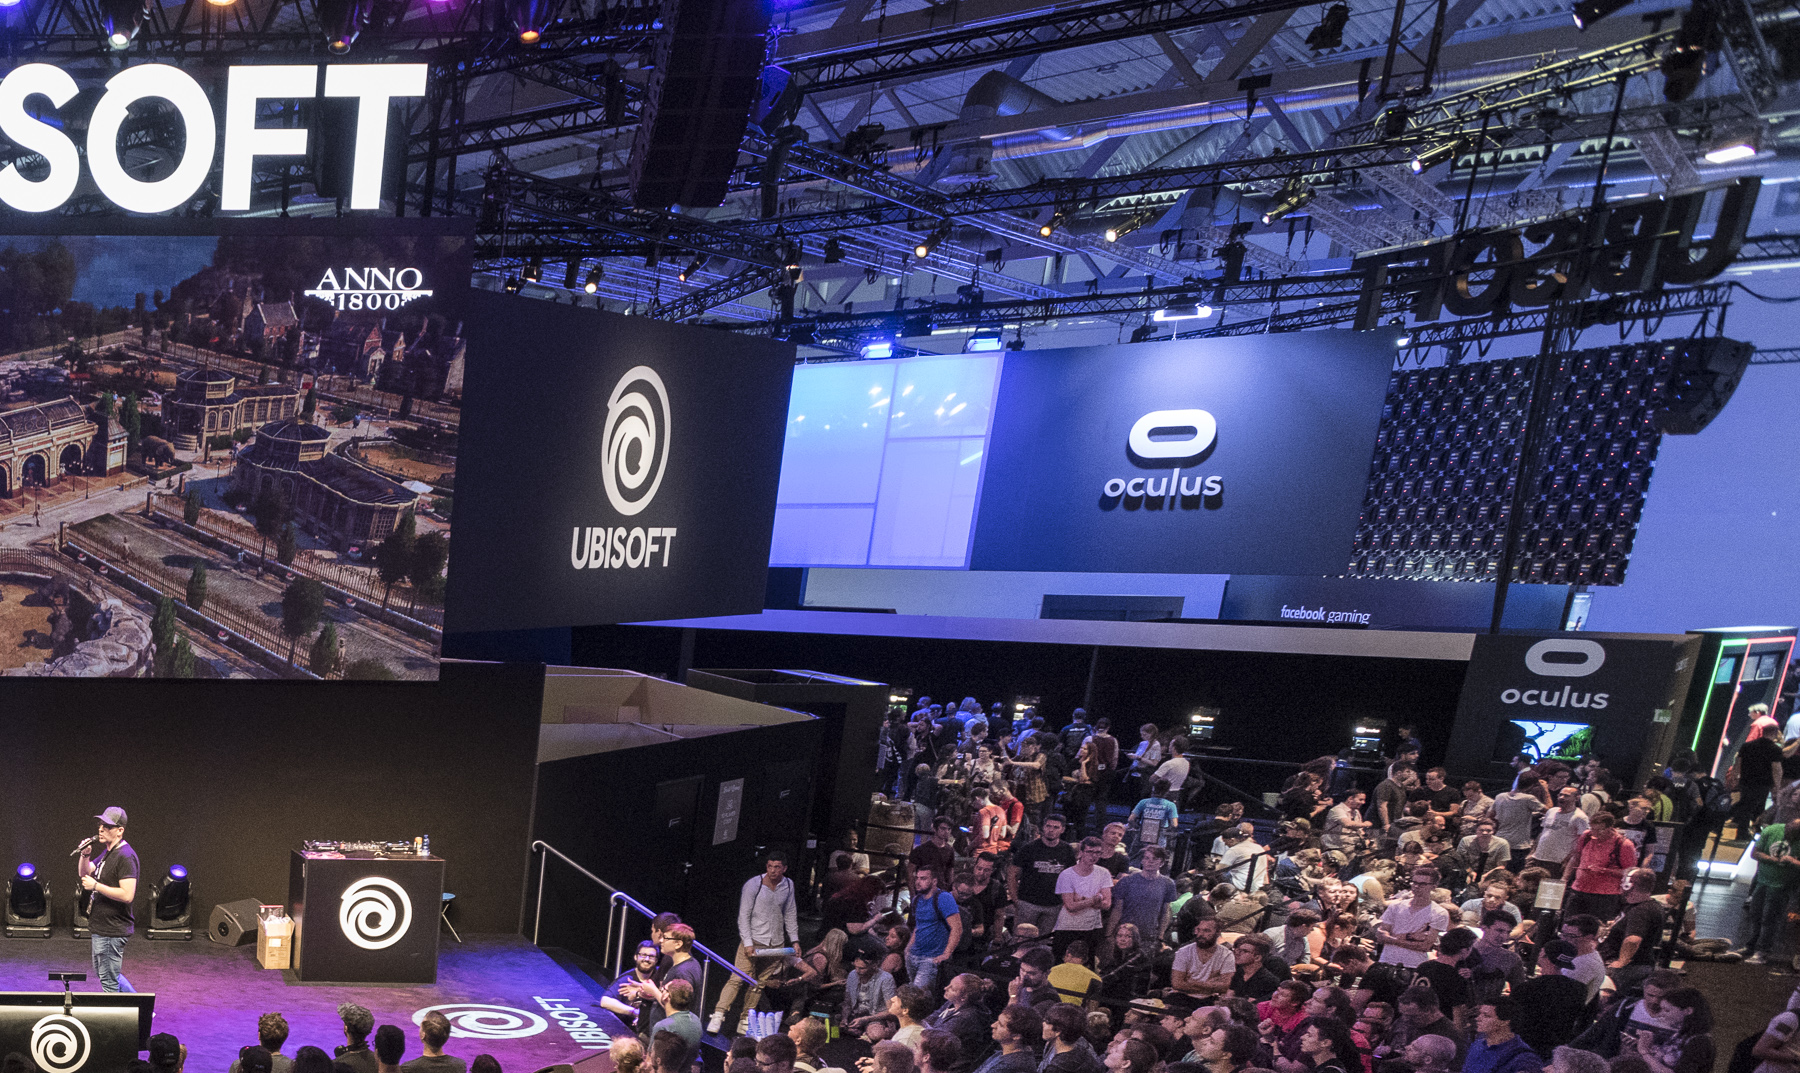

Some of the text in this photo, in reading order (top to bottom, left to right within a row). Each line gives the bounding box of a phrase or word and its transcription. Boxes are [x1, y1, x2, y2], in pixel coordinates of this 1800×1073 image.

[316, 267, 423, 290] ANNO
[338, 293, 400, 310] 1800
[1104, 468, 1223, 498] oculus
[571, 527, 677, 570] UBISOFT
[1281, 605, 1371, 624] facebook gaming
[1501, 685, 1610, 709] oculus
[532, 996, 614, 1049] UBISOFT
